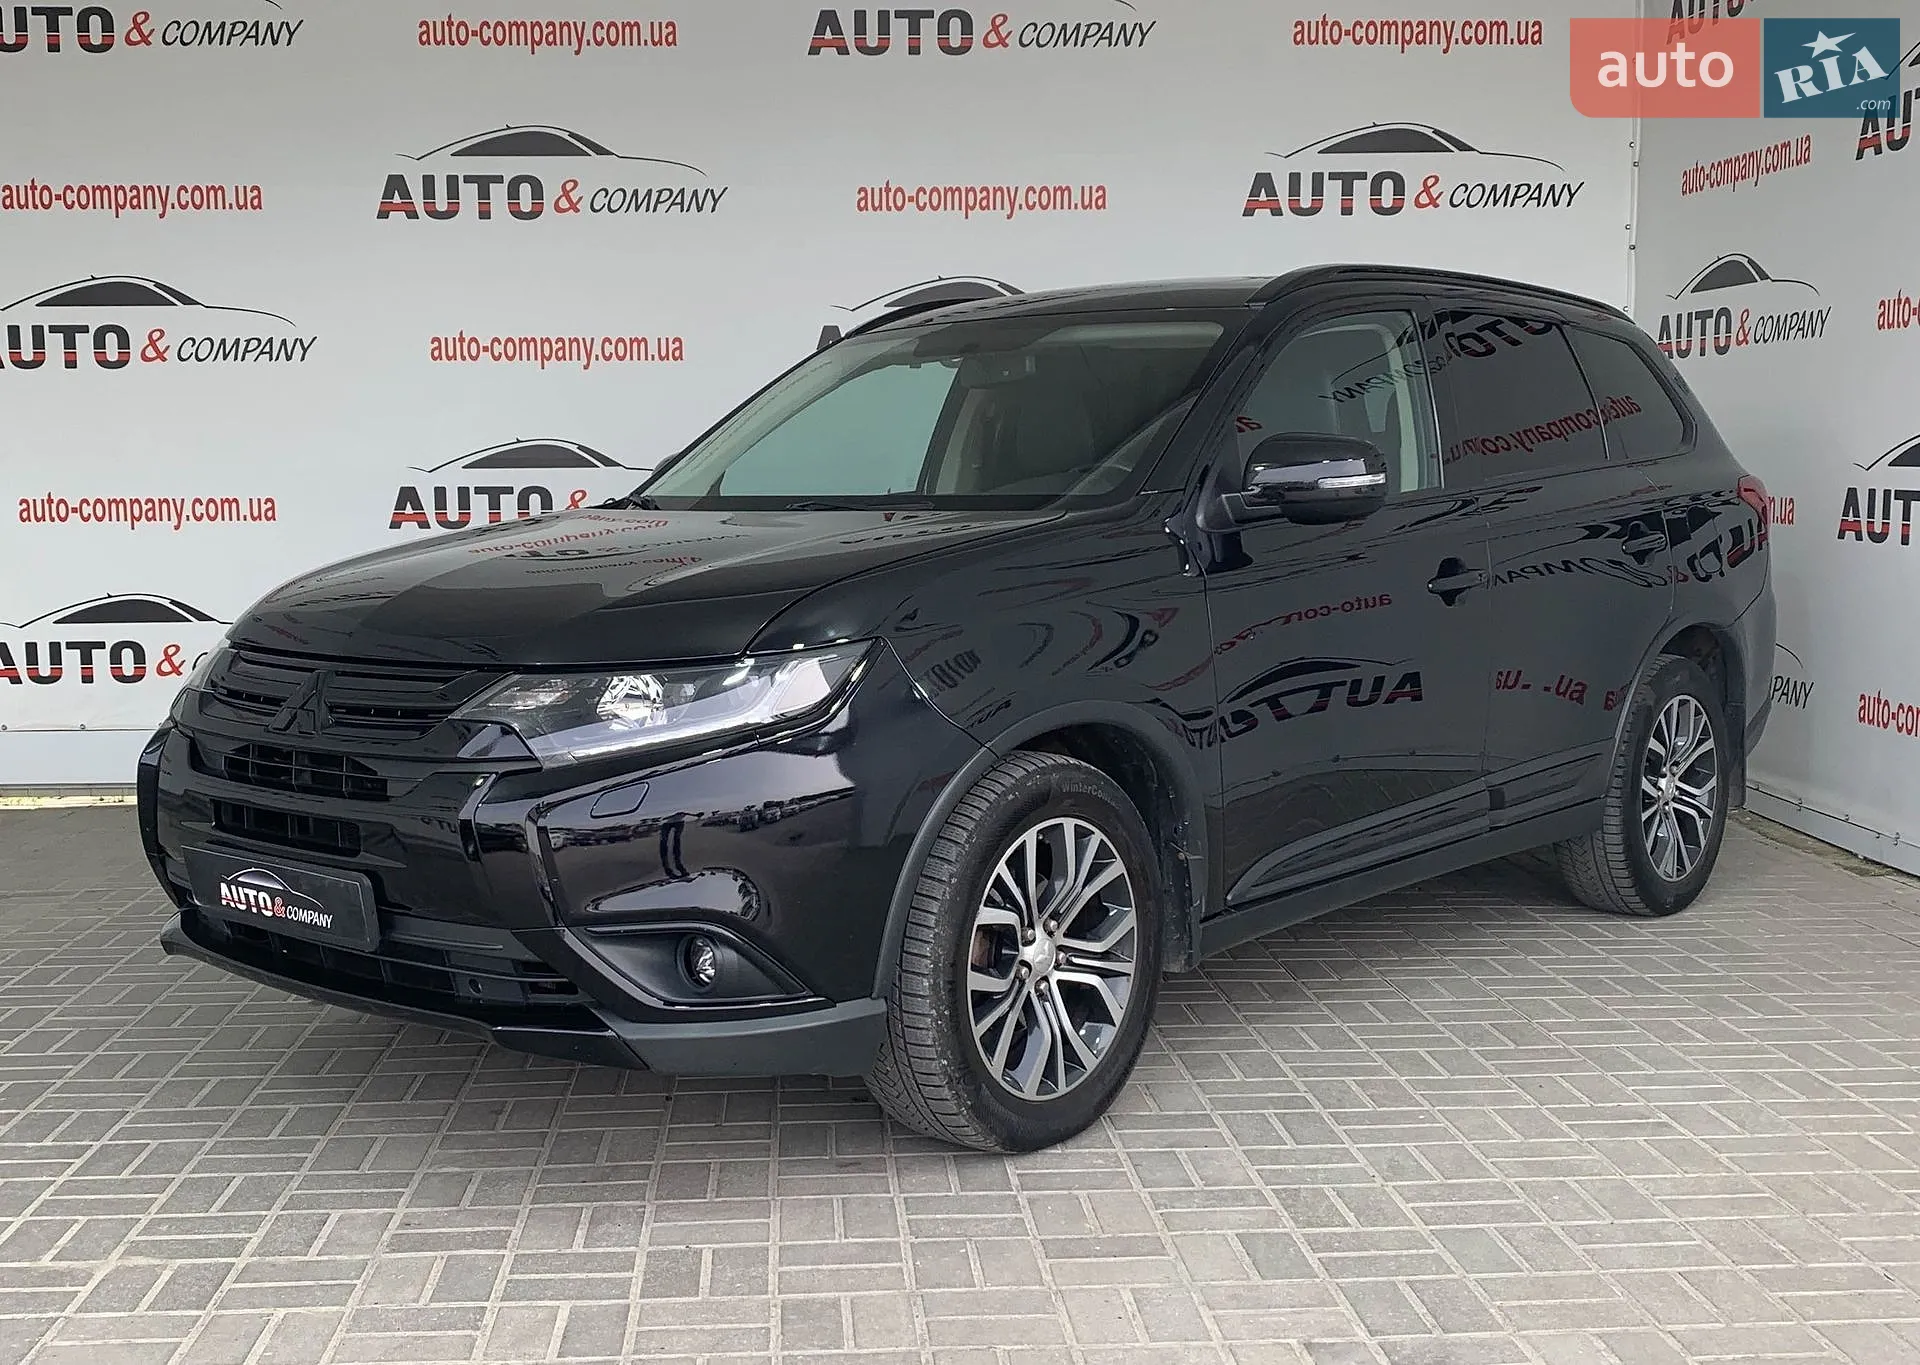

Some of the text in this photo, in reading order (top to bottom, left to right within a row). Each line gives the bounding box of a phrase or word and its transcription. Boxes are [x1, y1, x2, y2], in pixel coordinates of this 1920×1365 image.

[0, 6, 303, 53] UTO & COMPANY
[419, 13, 677, 55] auto-company.com.ua
[808, 9, 1156, 56] AUTO & COMPANY
[1294, 13, 1542, 54] auto-company.com.ua
[1855, 89, 1920, 161] AU
[1681, 135, 1811, 196] auto-company.com.ua
[2, 177, 262, 219] auto-company.com.ua
[377, 174, 728, 220] AUTO & COMPANY
[857, 180, 1106, 219] auto-company.com.ua
[1242, 171, 1584, 217] AUTO & COMPANY
[0, 324, 317, 369] UTO & COMPANY
[431, 330, 683, 370] auto-company.com.ua
[1657, 306, 1831, 359] AUTO & COMPANY
[19, 492, 276, 530] auto-company.com.ua
[389, 486, 553, 530] AUTO
[1838, 487, 1920, 546] AUT
[156, 644, 186, 676] &
[1769, 675, 1814, 709] PANY
[220, 882, 333, 929] AUTO & COMPANY
